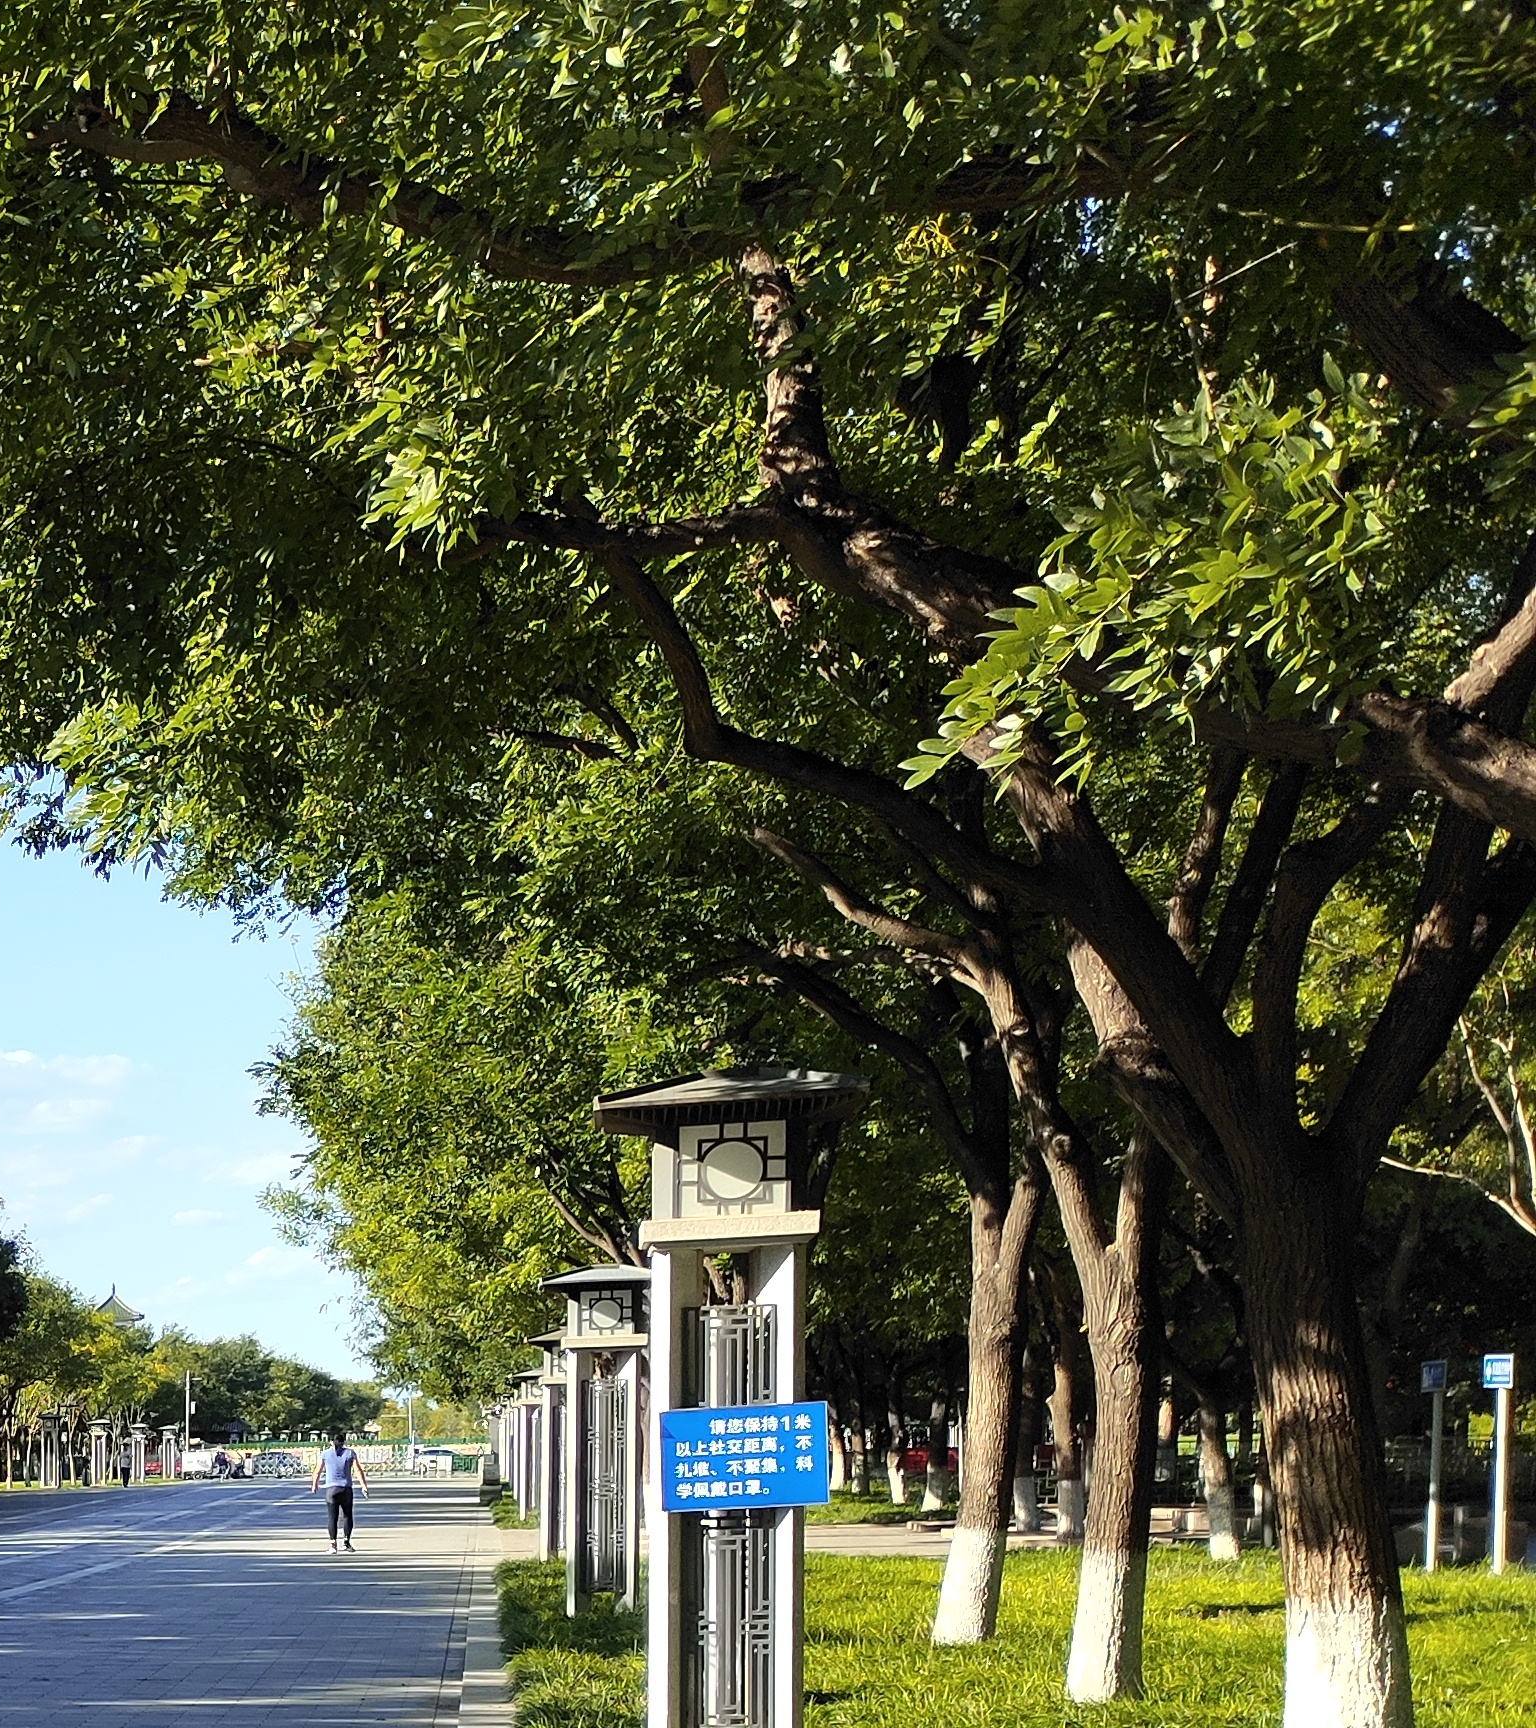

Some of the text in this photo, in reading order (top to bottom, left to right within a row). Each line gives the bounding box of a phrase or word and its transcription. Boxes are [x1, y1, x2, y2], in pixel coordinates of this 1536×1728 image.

[708, 1413, 811, 1435] 请您保持1米
